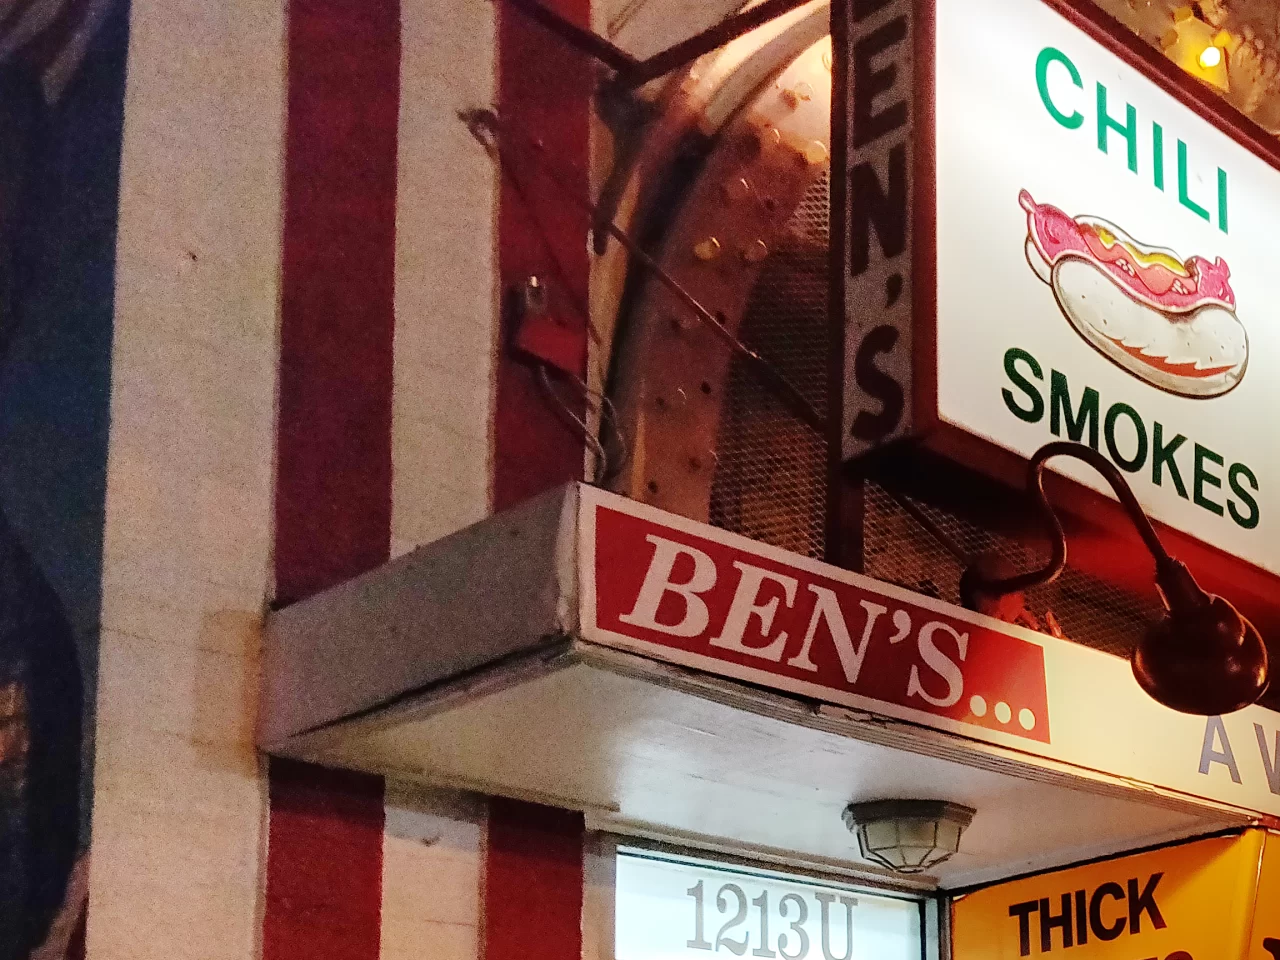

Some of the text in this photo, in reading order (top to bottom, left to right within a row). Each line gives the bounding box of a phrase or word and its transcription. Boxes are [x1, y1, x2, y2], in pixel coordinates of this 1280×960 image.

[850, 0, 910, 442] EN'S
[1036, 46, 1228, 234] CHILI
[1001, 347, 1260, 529] SMOKES
[1198, 714, 1243, 784] A
[1008, 872, 1167, 957] THICK
